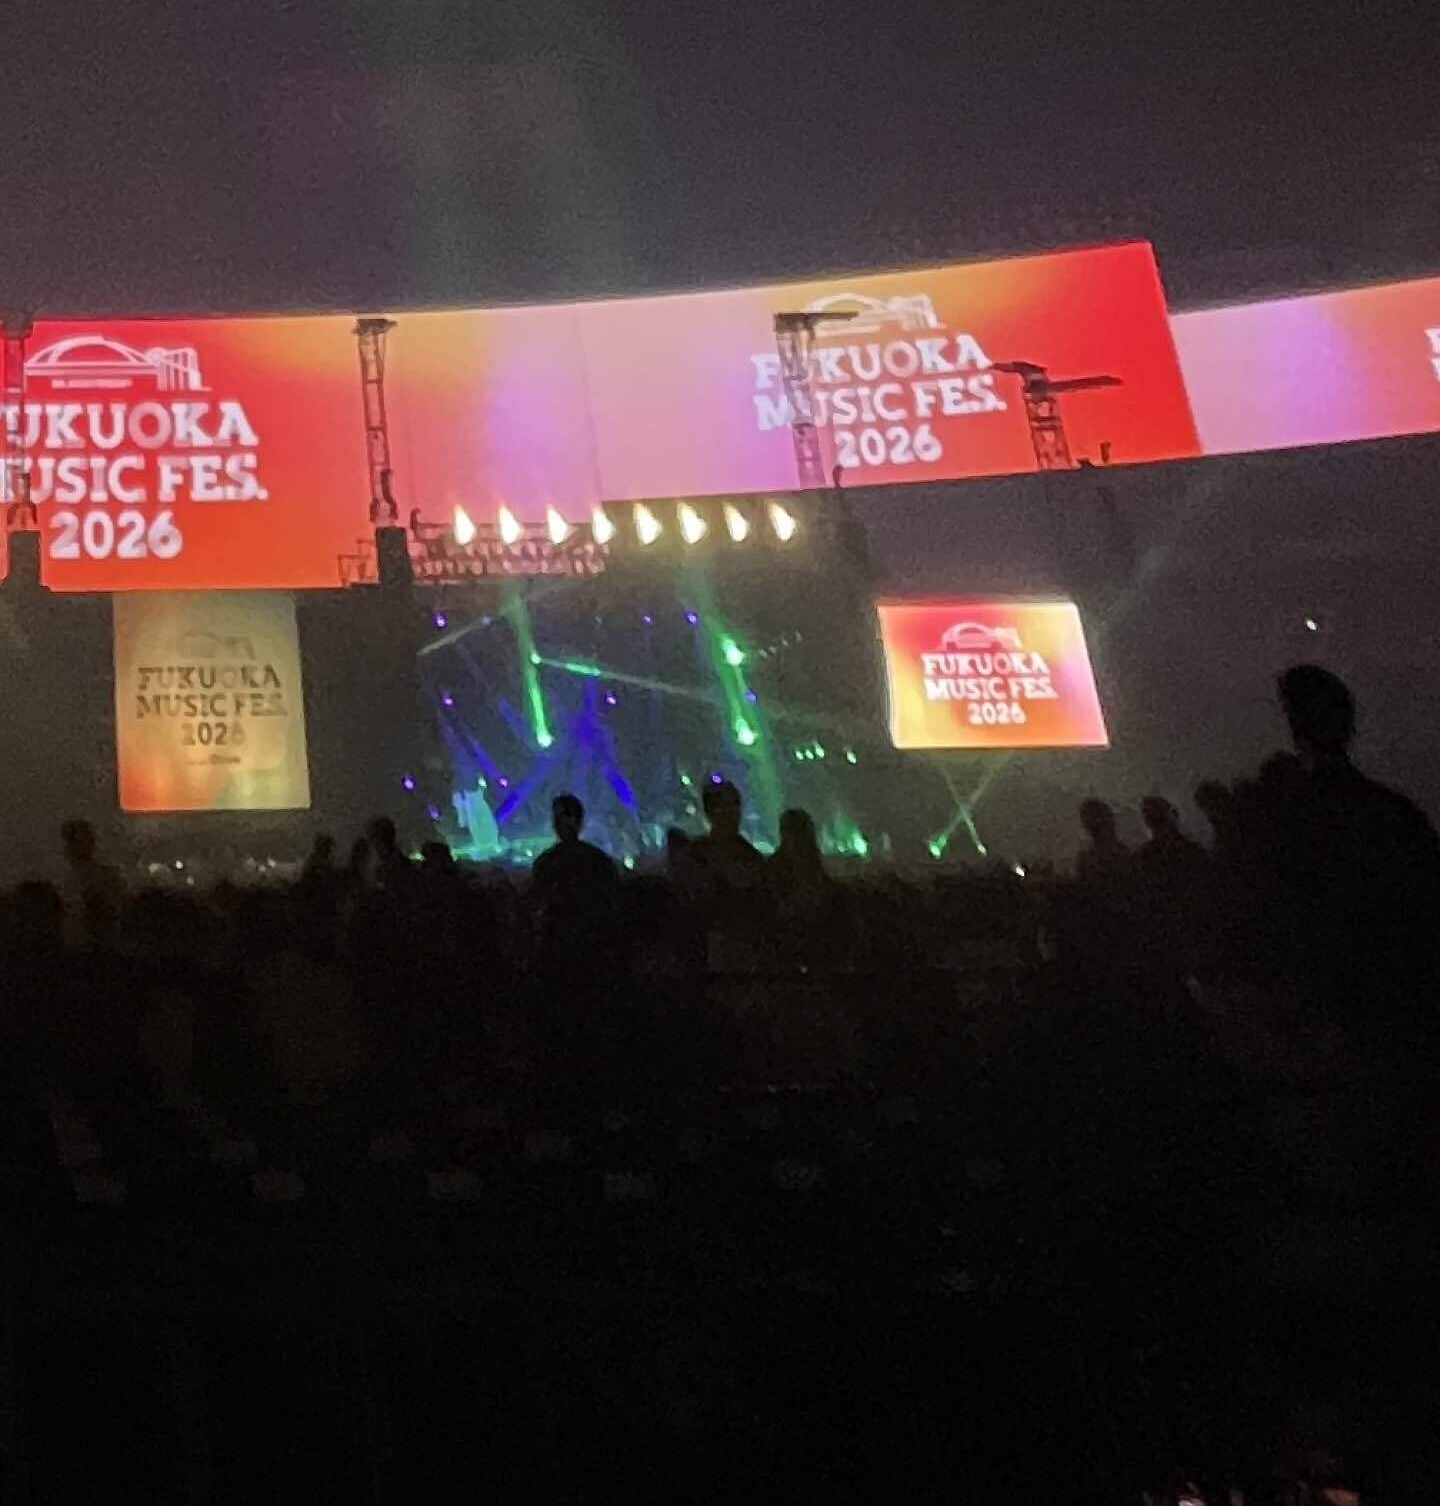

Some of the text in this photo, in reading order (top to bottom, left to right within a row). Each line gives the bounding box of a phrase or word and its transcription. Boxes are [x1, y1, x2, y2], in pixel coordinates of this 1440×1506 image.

[751, 334, 993, 389] FKUOKA
[911, 374, 1008, 418] FES.
[833, 424, 943, 469] 2026
[157, 453, 268, 502] FES.
[49, 510, 183, 559] 2026
[137, 664, 281, 690] FUKUOKA
[920, 653, 1050, 675] FUKUOKA
[136, 694, 227, 718] MUSIC
[924, 678, 1006, 701] MUSIC
[968, 702, 1026, 725] 2026
